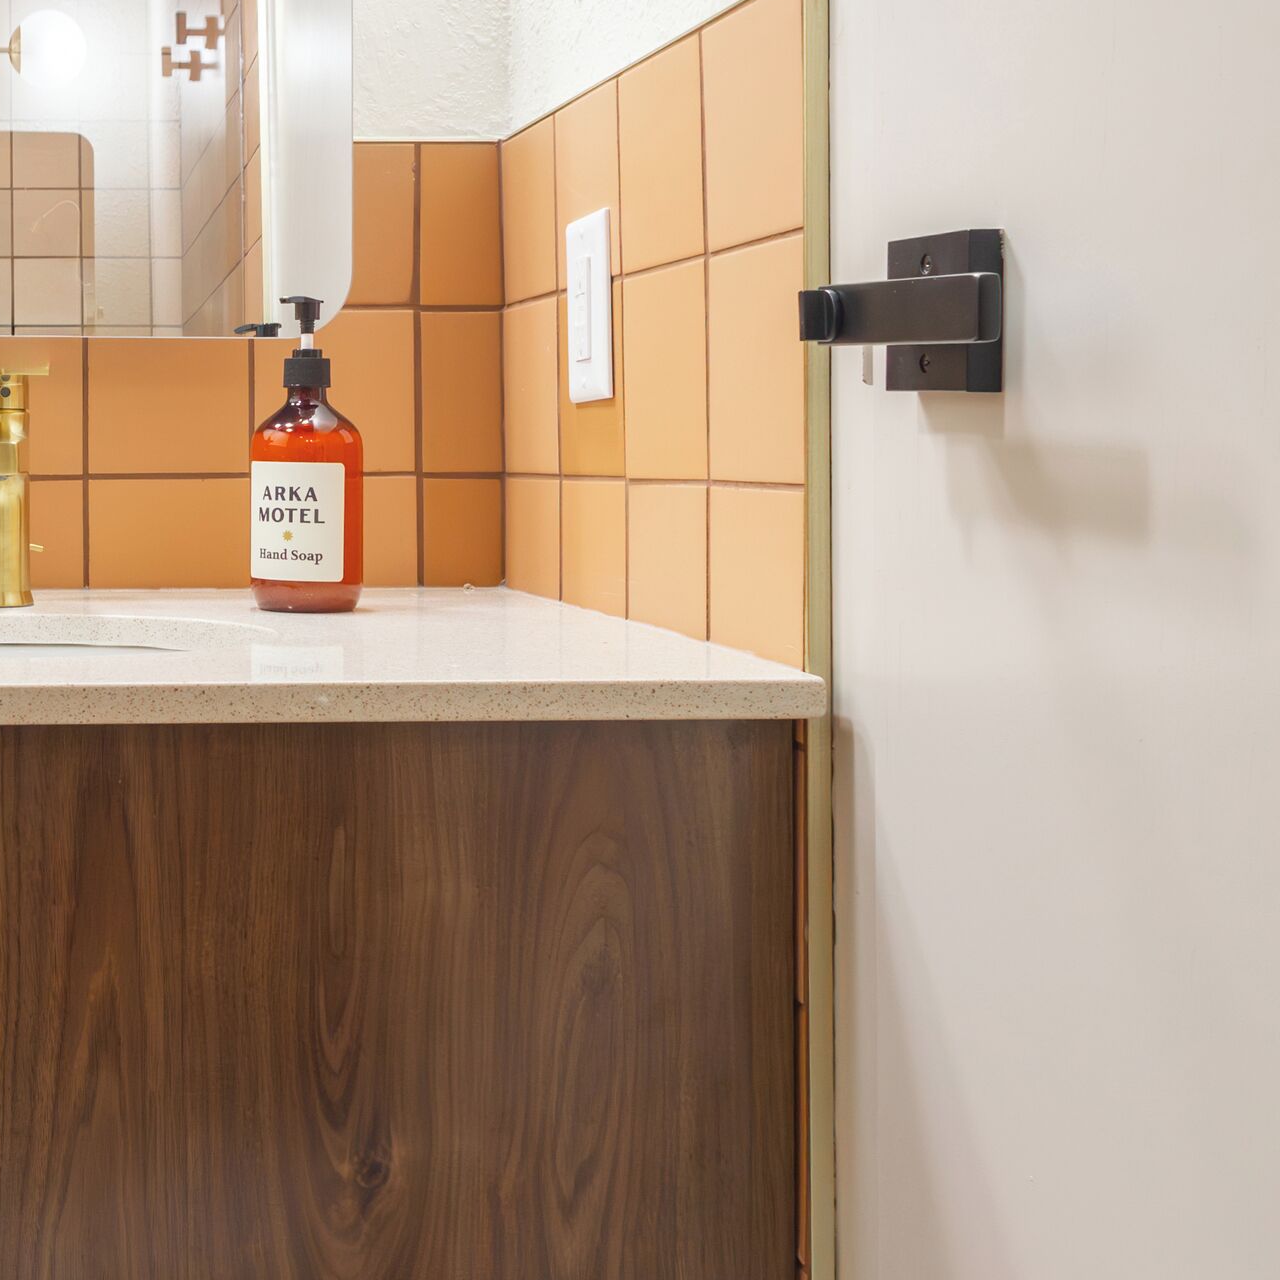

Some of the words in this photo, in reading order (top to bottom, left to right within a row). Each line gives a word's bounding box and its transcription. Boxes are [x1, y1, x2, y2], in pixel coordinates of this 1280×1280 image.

[263, 485, 318, 502] ARKA
[258, 507, 325, 524] MOTEL
[260, 548, 288, 561] Hand
[291, 550, 323, 565] Soap
